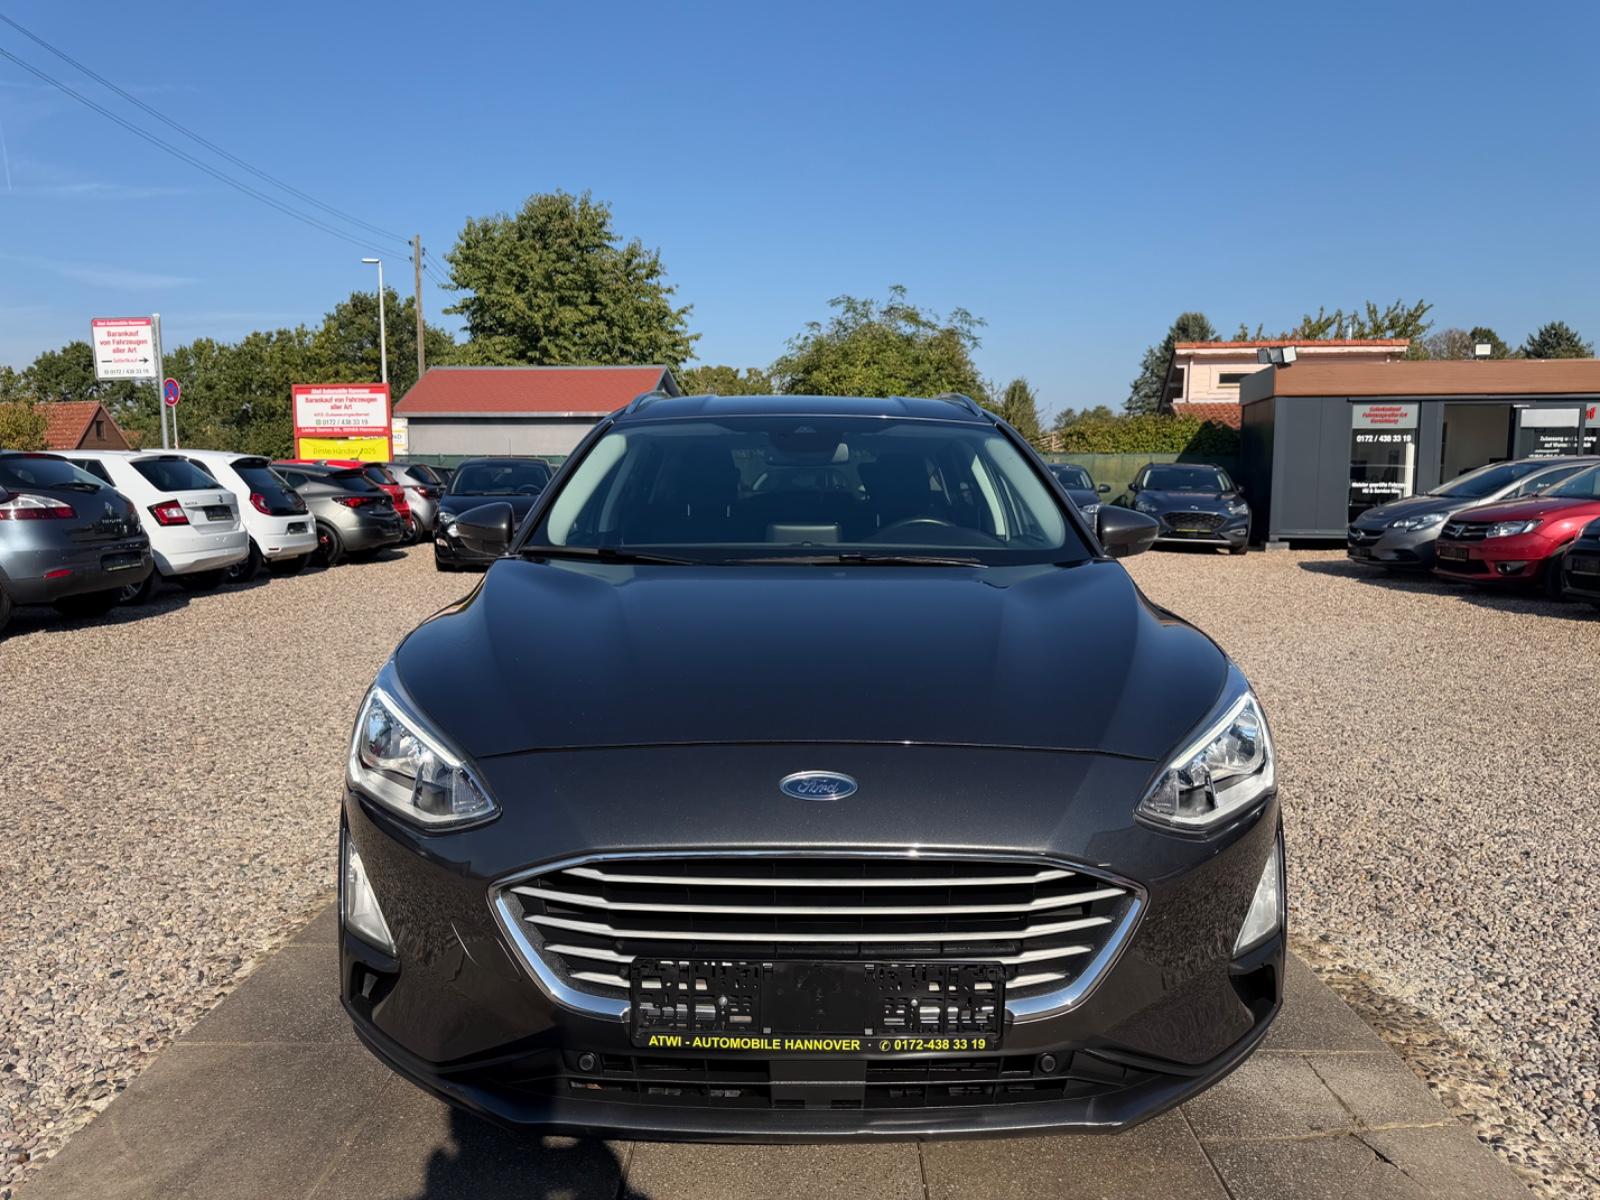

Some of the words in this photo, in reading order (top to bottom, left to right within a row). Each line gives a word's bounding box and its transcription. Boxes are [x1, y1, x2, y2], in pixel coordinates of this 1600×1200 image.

[1356, 434, 1374, 442] 0172
[1379, 434, 1392, 442] 438
[1393, 434, 1401, 442] 33
[797, 779, 840, 793] Ford
[649, 1035, 682, 1048] ATWI
[692, 1036, 781, 1050] AUTOMOBILE
[784, 1038, 861, 1051] HANNOVER
[893, 1038, 950, 1050] 0172-438
[953, 1038, 968, 1050] 33
[971, 1038, 986, 1050] 19
